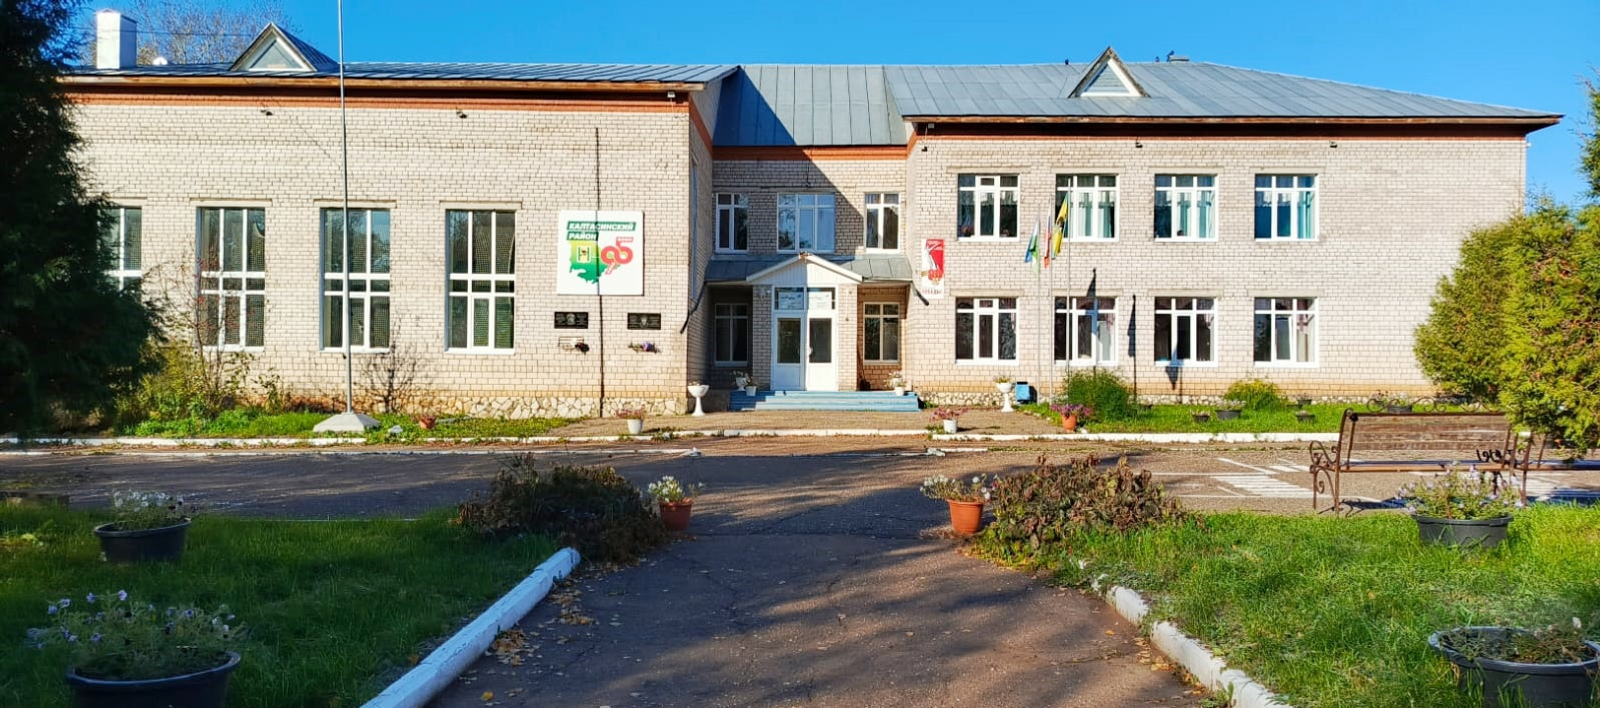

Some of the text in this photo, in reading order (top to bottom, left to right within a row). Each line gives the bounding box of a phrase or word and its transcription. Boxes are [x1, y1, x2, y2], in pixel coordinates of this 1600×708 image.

[568, 222, 634, 231] КАЛТАСИНСКИЙ
[568, 232, 597, 240] РАЙОН
[601, 236, 633, 275] 95
